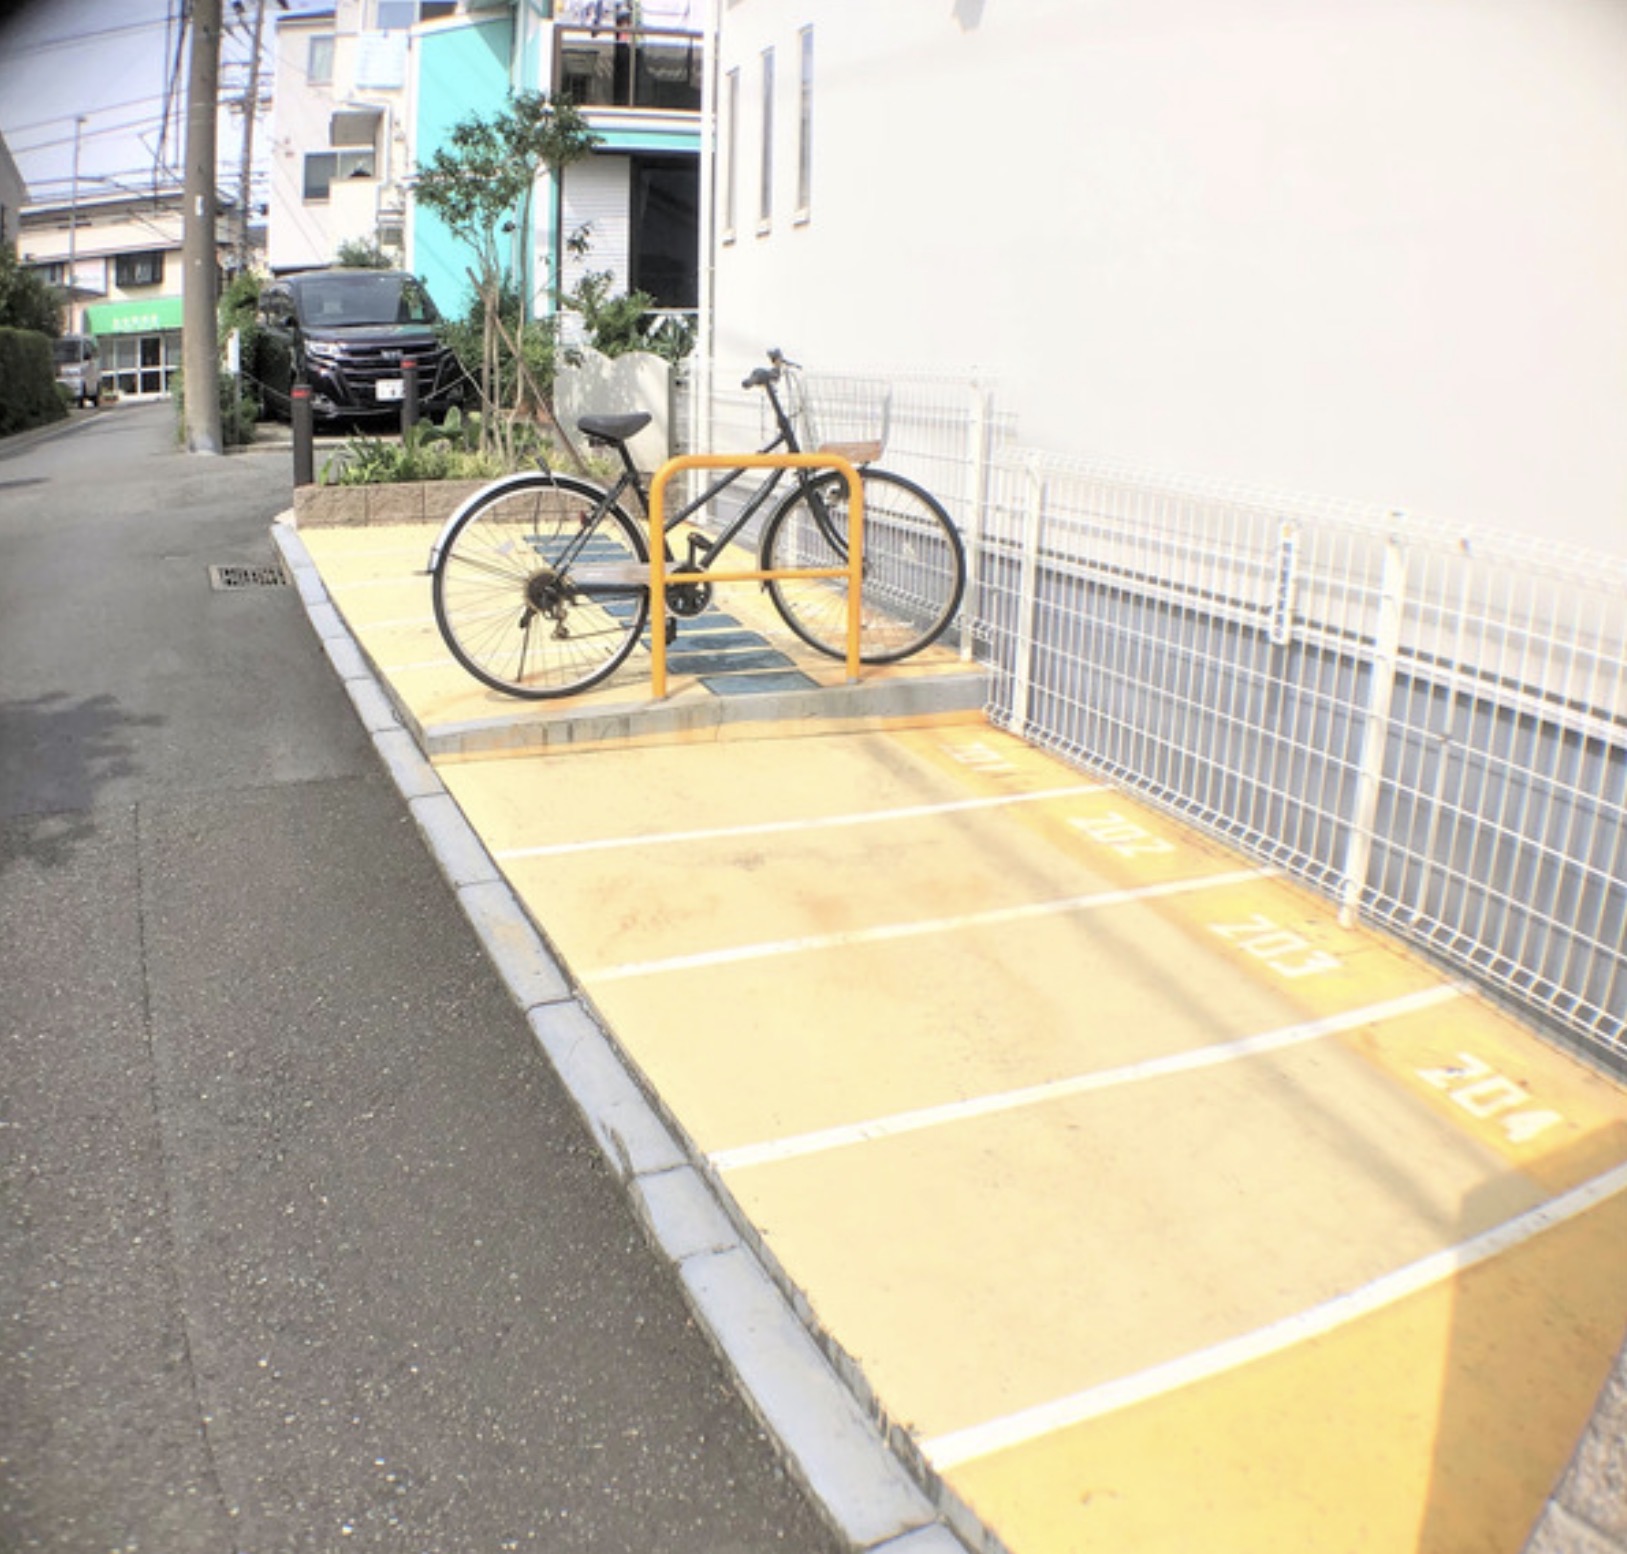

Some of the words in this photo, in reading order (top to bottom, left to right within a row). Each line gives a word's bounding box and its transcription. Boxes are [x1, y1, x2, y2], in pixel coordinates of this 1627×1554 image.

[1066, 811, 1175, 857] 202
[1207, 913, 1343, 978] 203
[1413, 1051, 1563, 1143] 204
